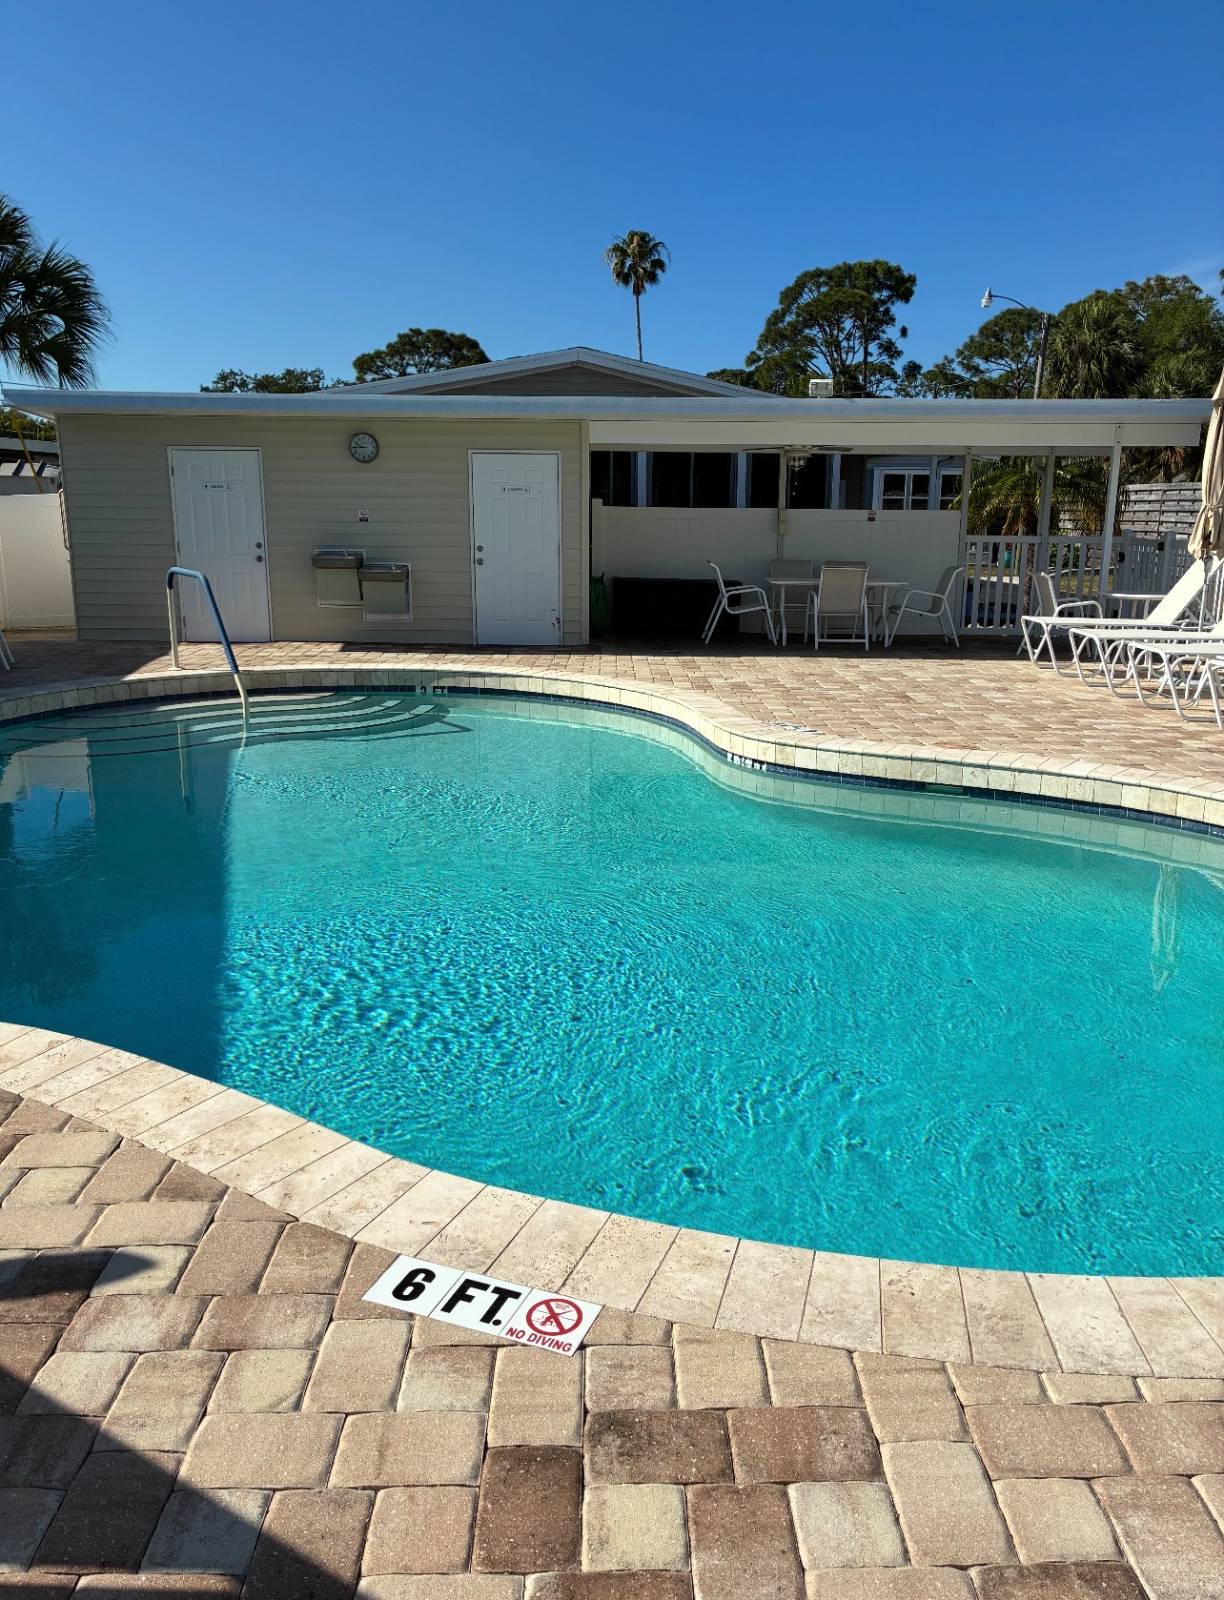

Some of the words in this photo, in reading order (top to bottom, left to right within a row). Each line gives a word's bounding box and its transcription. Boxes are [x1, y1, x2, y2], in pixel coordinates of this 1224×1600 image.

[392, 1268, 436, 1301] 6
[440, 1278, 522, 1326] FT.
[505, 1327, 525, 1340] NO
[527, 1333, 572, 1352] DIVING
